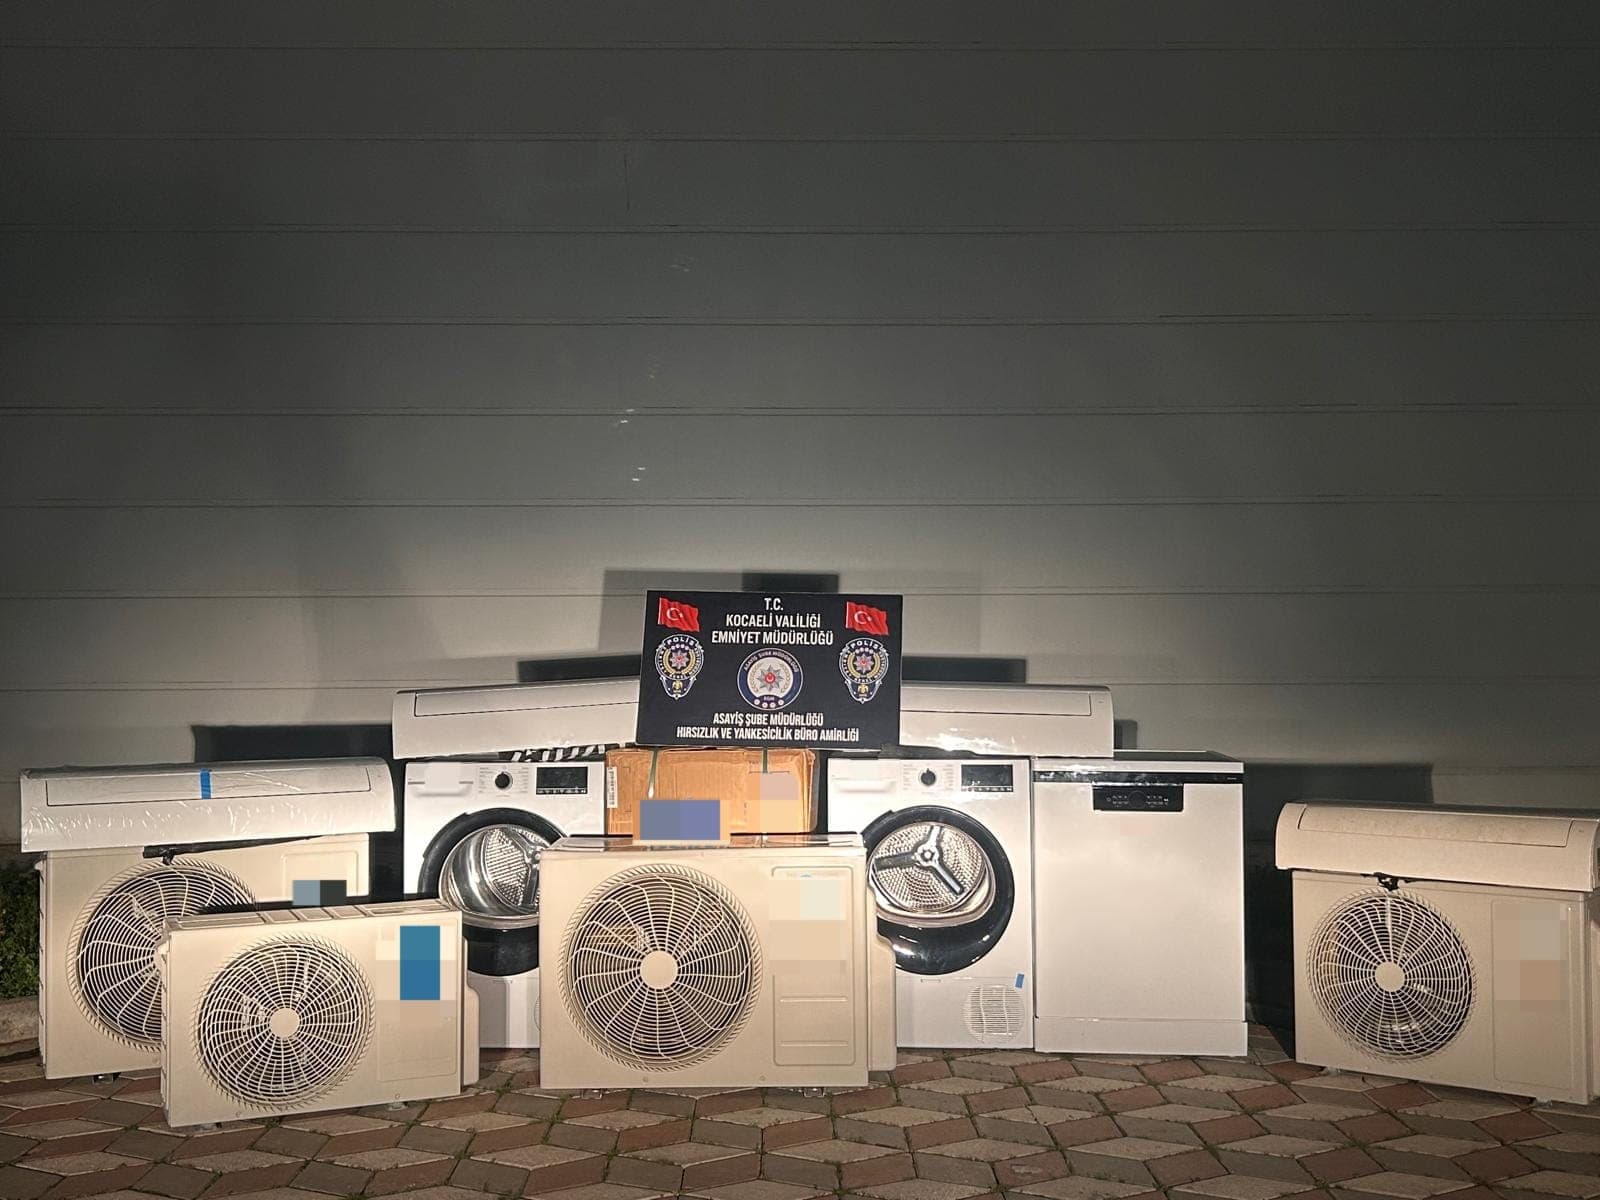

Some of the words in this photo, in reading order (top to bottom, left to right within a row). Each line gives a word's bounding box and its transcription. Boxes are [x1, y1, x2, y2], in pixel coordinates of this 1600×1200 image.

[764, 597, 784, 611] T.C.
[726, 612, 773, 627] KOCAELİ
[775, 613, 821, 628] VALİLİĞİ
[711, 629, 760, 644] EMNİYET
[762, 630, 834, 645] MÜDÜRLÜĞÜ
[713, 711, 745, 727] ASAYİŞ
[745, 713, 769, 727] ŞUBE
[769, 711, 824, 727] MÜDÜRLÜĞÜ
[676, 726, 719, 739] HIRSIZLIK
[720, 727, 733, 739] VE
[734, 726, 793, 740] YANKESİCİLİK
[794, 727, 818, 741] BÜRO
[819, 727, 859, 742] AMİRLİĞİ
